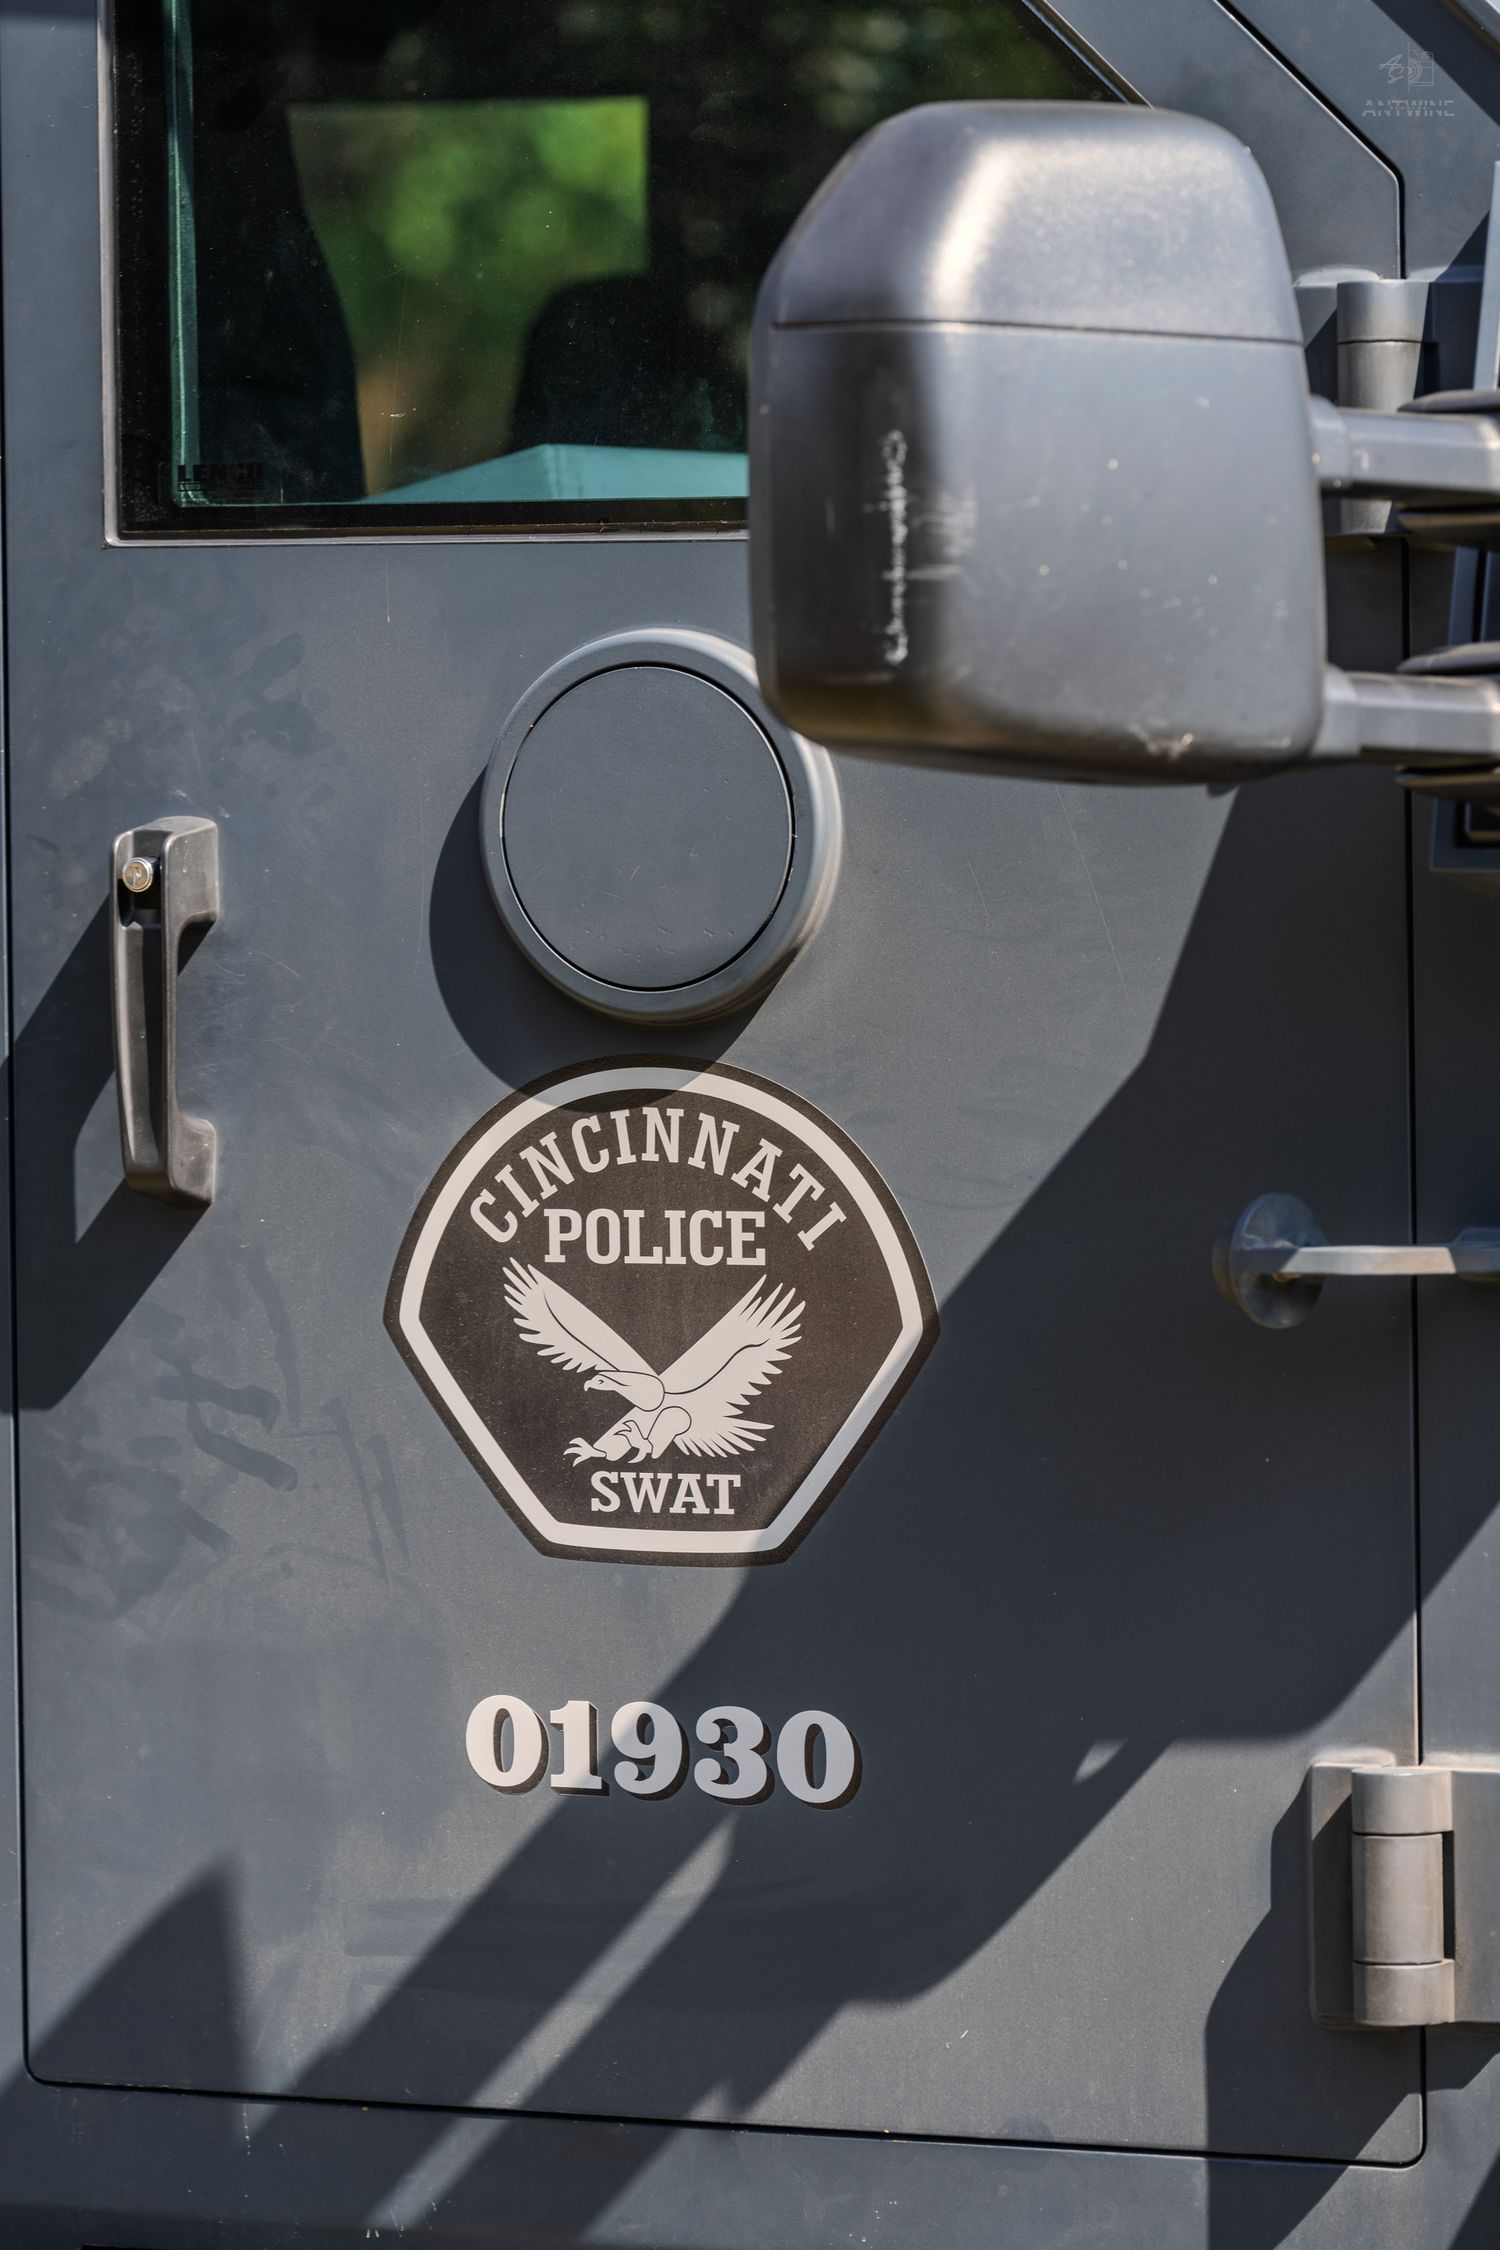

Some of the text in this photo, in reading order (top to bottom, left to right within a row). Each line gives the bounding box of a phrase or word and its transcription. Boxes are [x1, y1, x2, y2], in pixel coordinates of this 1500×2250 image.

[470, 1107, 846, 1251] CINCINNATI
[543, 1208, 766, 1266] POLICE
[590, 1471, 741, 1515] SWAT
[465, 1694, 863, 1811] 01930
